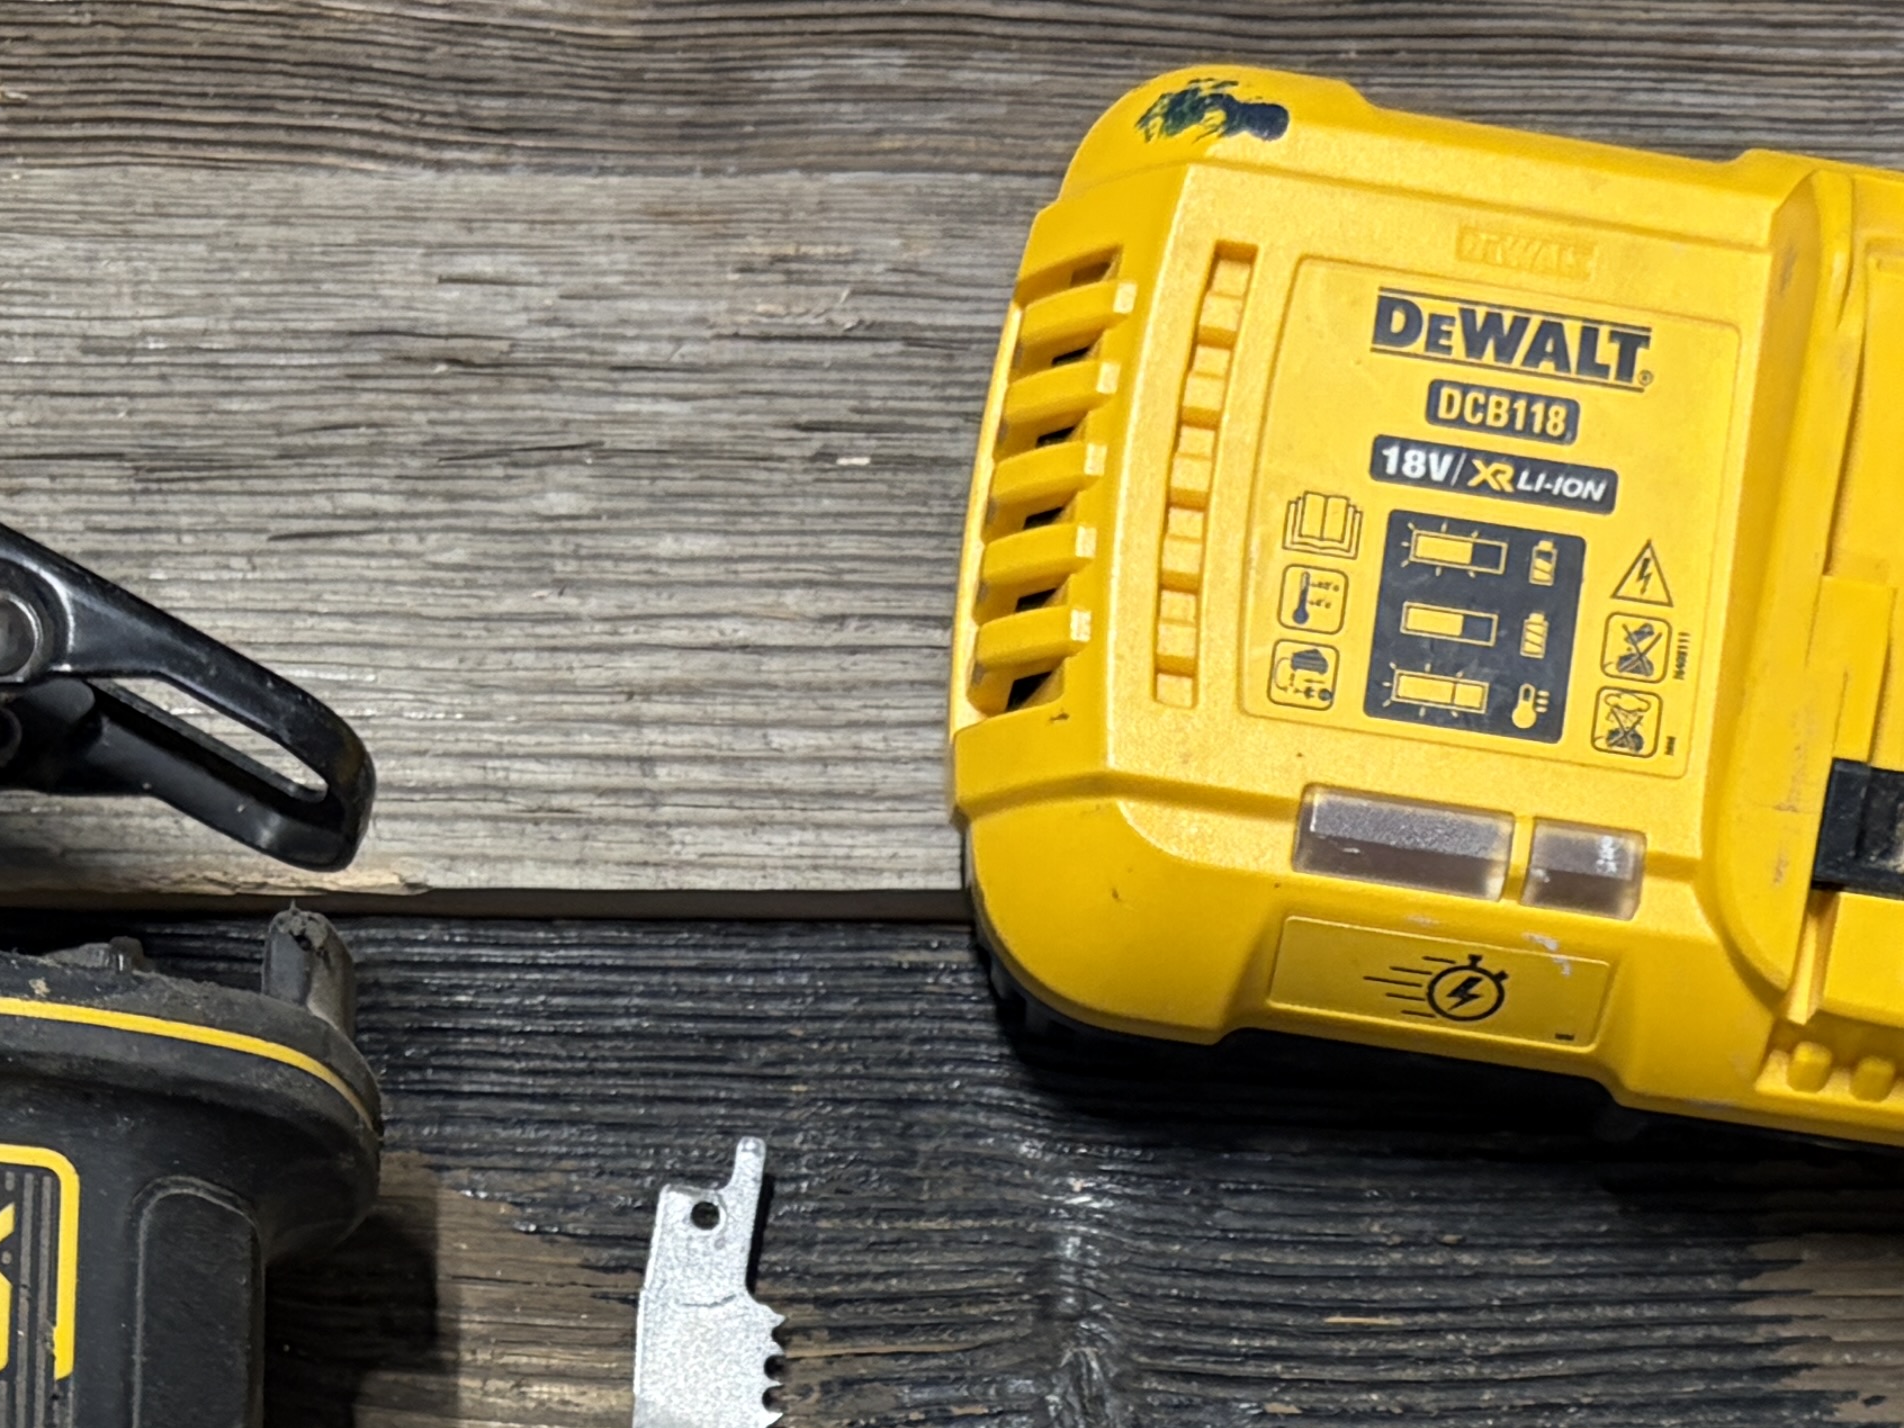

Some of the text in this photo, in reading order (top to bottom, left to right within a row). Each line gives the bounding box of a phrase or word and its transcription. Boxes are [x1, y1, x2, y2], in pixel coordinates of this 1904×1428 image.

[1371, 295, 1652, 384] DEWALT
[1437, 386, 1567, 438] DCB118
[1467, 458, 1515, 493] XR
[1517, 469, 1607, 502] LI-ION
